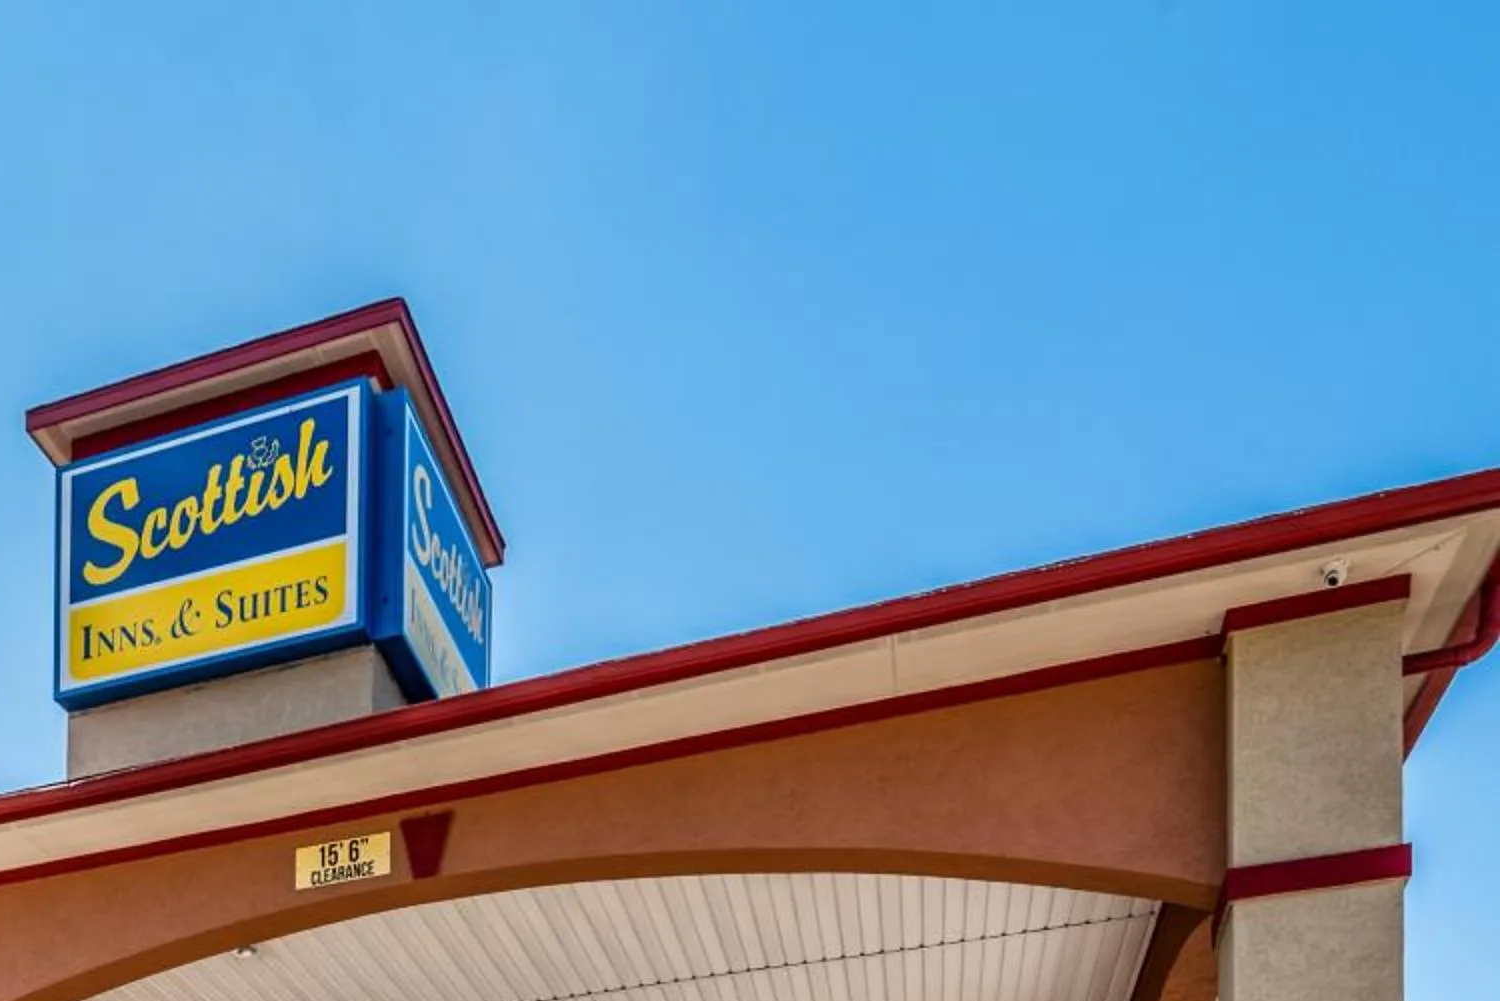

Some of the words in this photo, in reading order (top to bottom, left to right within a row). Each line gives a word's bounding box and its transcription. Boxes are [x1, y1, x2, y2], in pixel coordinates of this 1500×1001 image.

[83, 418, 332, 585] Scottish
[412, 464, 484, 644] Scottish
[171, 598, 201, 639] &
[214, 576, 329, 629] SUITES
[311, 860, 375, 885] CLEARANCE
